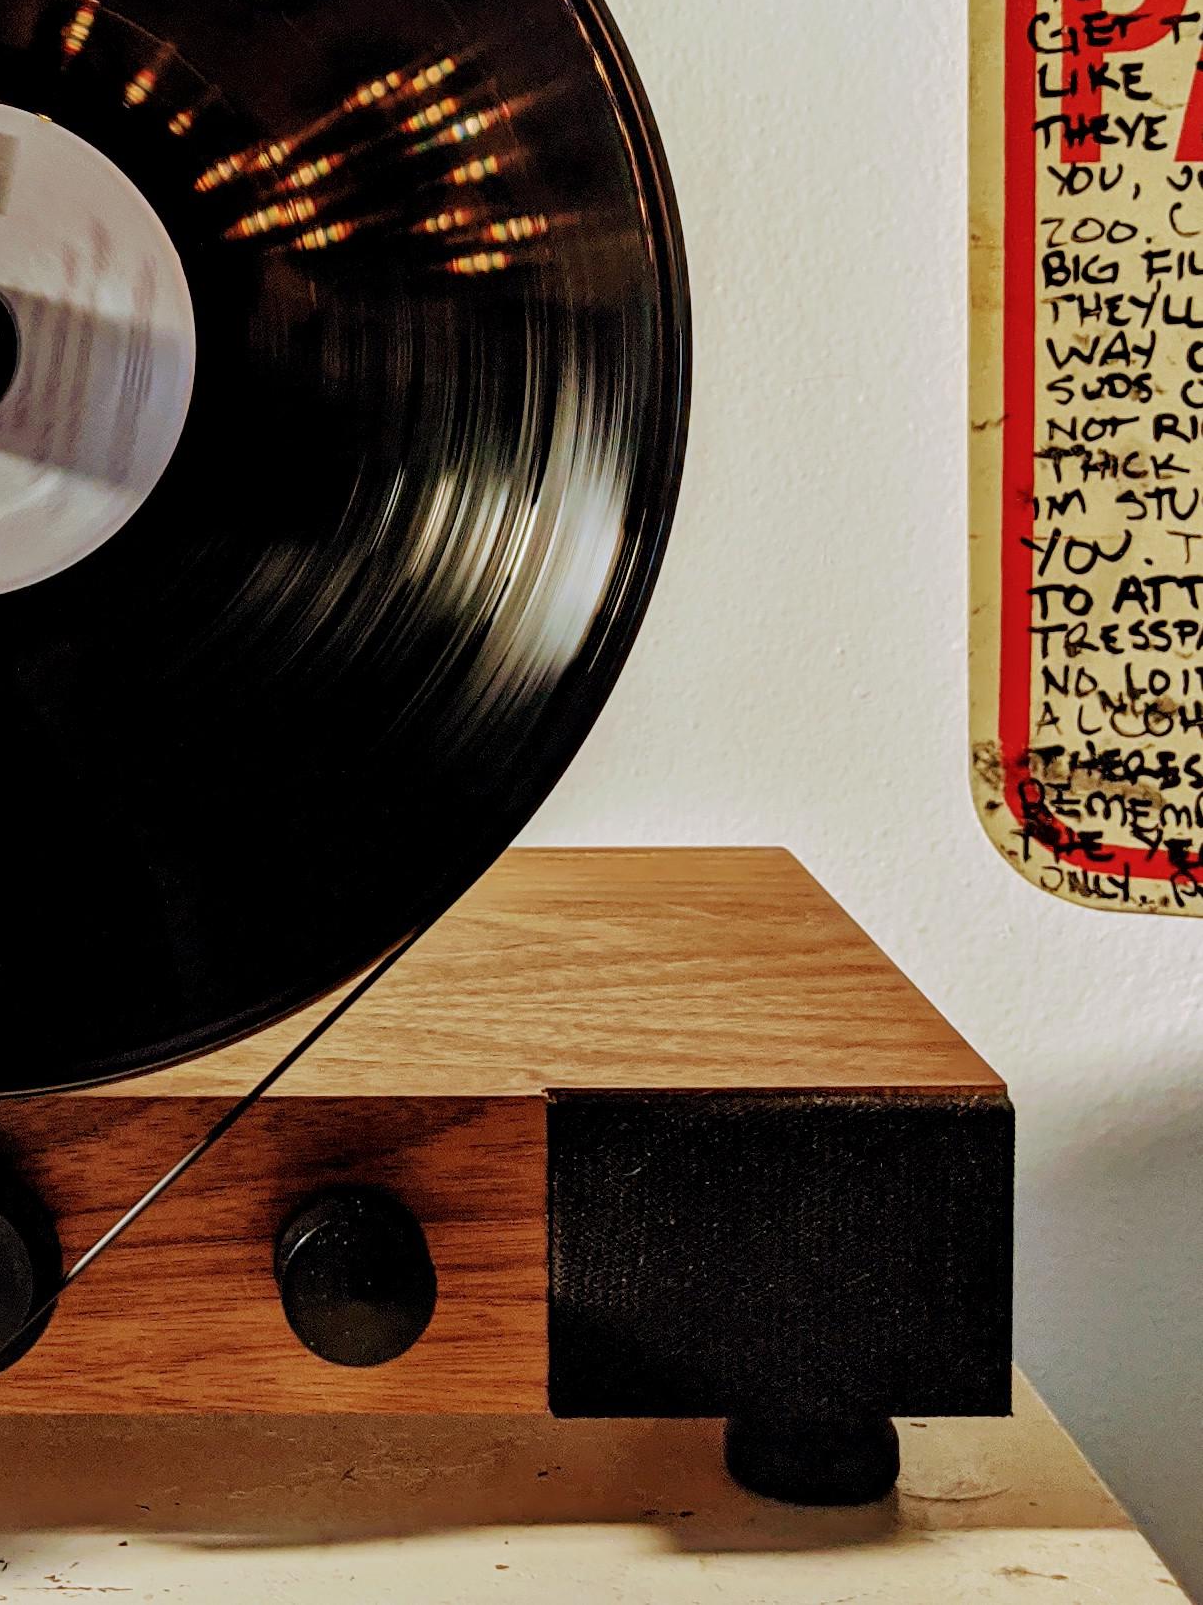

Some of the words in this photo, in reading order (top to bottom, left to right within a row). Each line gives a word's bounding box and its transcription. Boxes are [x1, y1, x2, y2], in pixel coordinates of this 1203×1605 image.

[1027, 10, 1152, 56] GET
[1037, 62, 1153, 101] LIKE
[1041, 250, 1120, 289] BIG
[1046, 330, 1157, 370] WAY
[1047, 416, 1140, 442] NOT
[1027, 584, 1094, 620] TO
